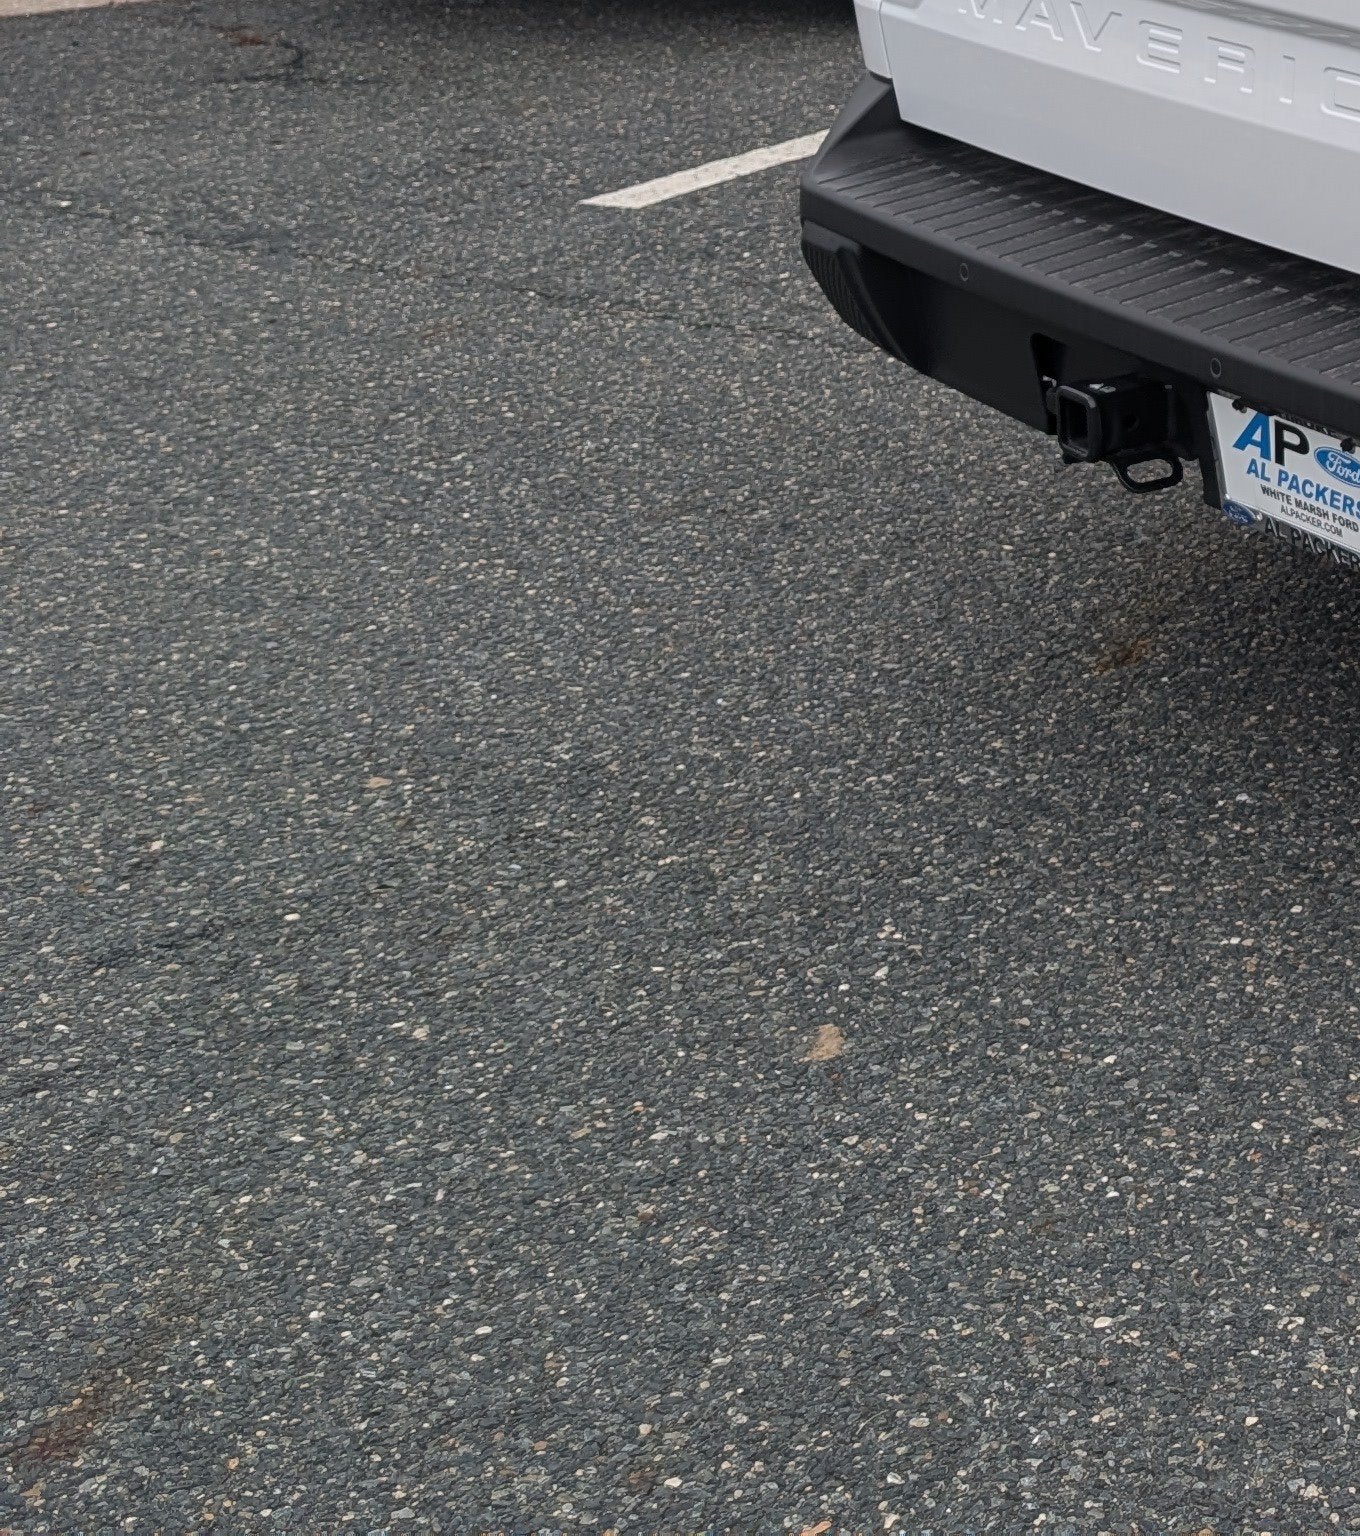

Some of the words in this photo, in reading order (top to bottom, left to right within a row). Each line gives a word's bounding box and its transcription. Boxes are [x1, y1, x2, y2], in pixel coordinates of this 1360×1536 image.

[1232, 412, 1310, 467] AP
[1247, 458, 1271, 483] AL
[1260, 483, 1292, 506] WHITE
[1294, 498, 1331, 521] MARSH
[1332, 511, 1360, 533] FORD
[1280, 504, 1344, 538] ALPACKER.COM
[1265, 517, 1288, 539] AL
